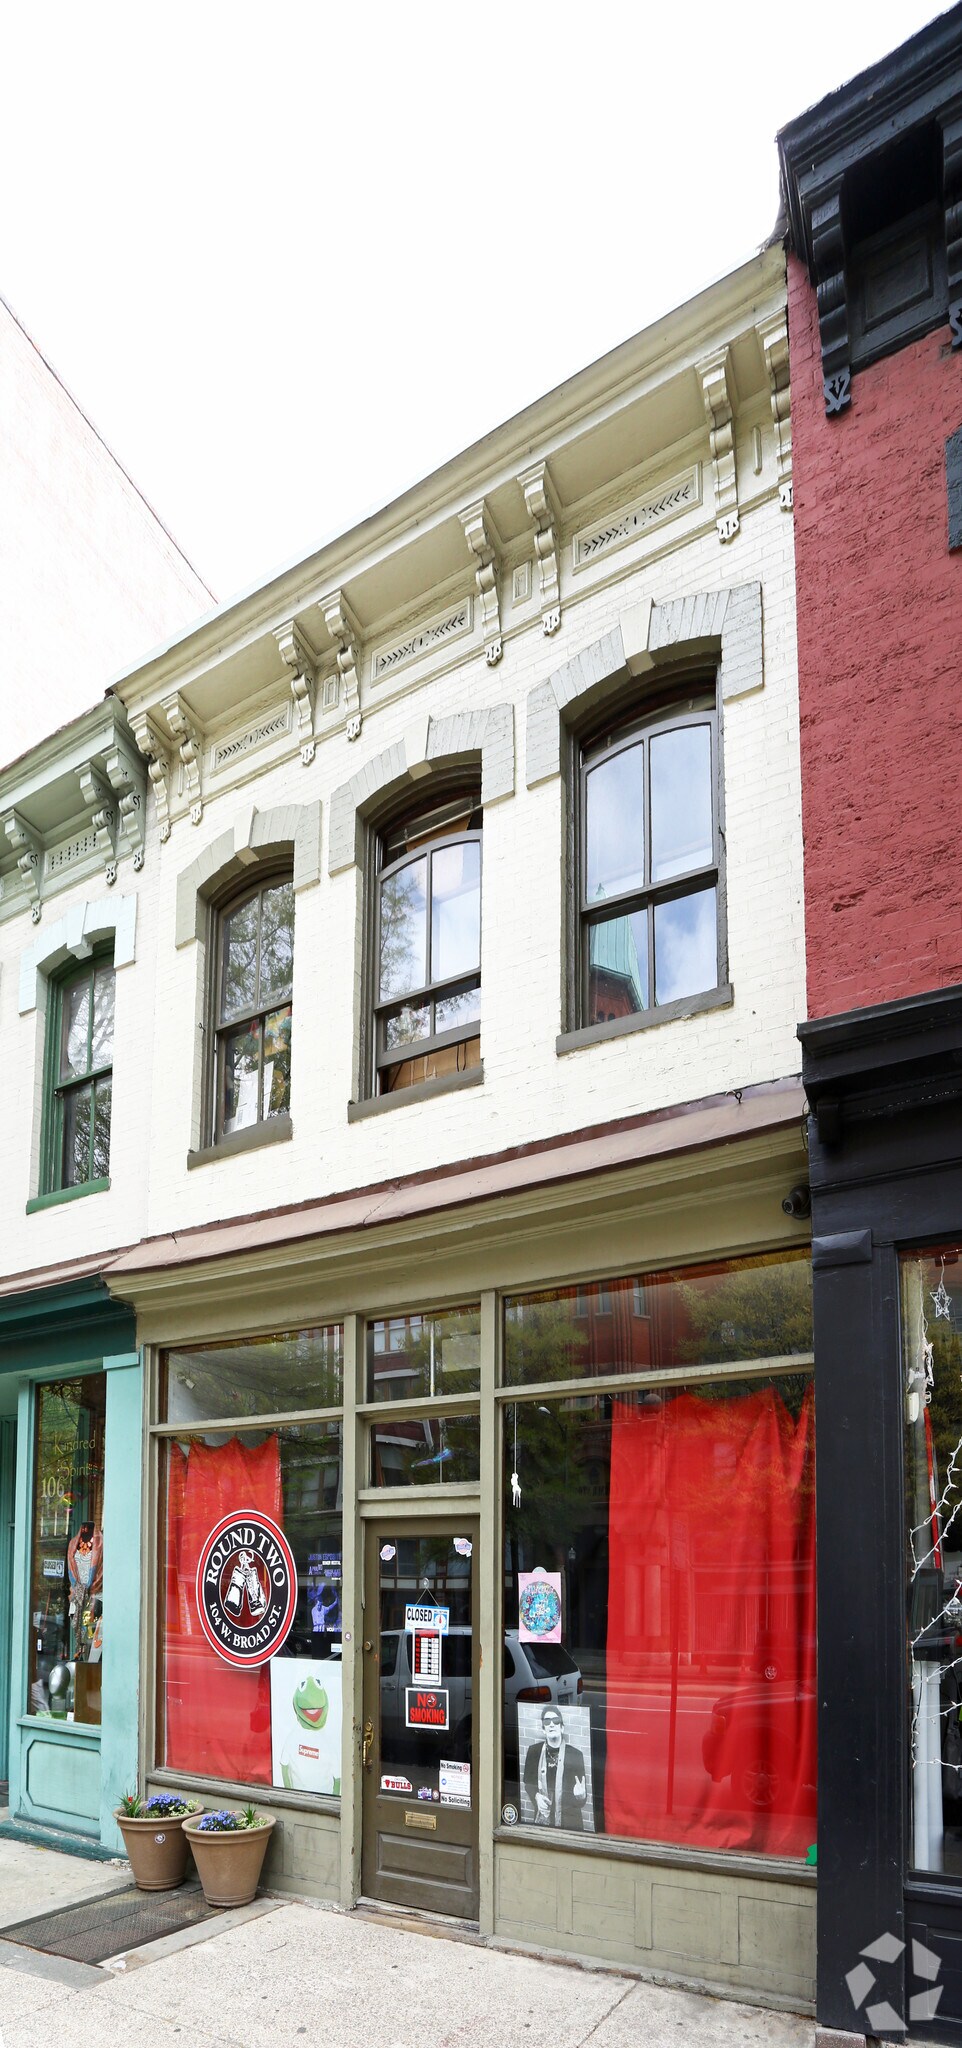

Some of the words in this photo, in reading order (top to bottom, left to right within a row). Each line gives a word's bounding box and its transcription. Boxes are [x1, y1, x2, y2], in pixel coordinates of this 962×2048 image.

[54, 1430, 96, 1455] Kindred
[41, 1476, 65, 1498] 106
[206, 1527, 256, 1586] ROUND
[256, 1532, 286, 1587] TWO
[407, 1608, 433, 1622] CLOSED
[209, 1602, 222, 1626] 104
[220, 1623, 231, 1642] W.
[232, 1625, 271, 1649] BROAD
[268, 1605, 282, 1628] ST.
[417, 1693, 437, 1708] NO
[410, 1707, 445, 1724] SMOKING
[299, 1745, 319, 1757] Supreme
[446, 1763, 462, 1772] Smoking
[391, 1781, 411, 1790] BULLS
[448, 1796, 470, 1806] Soliciting
